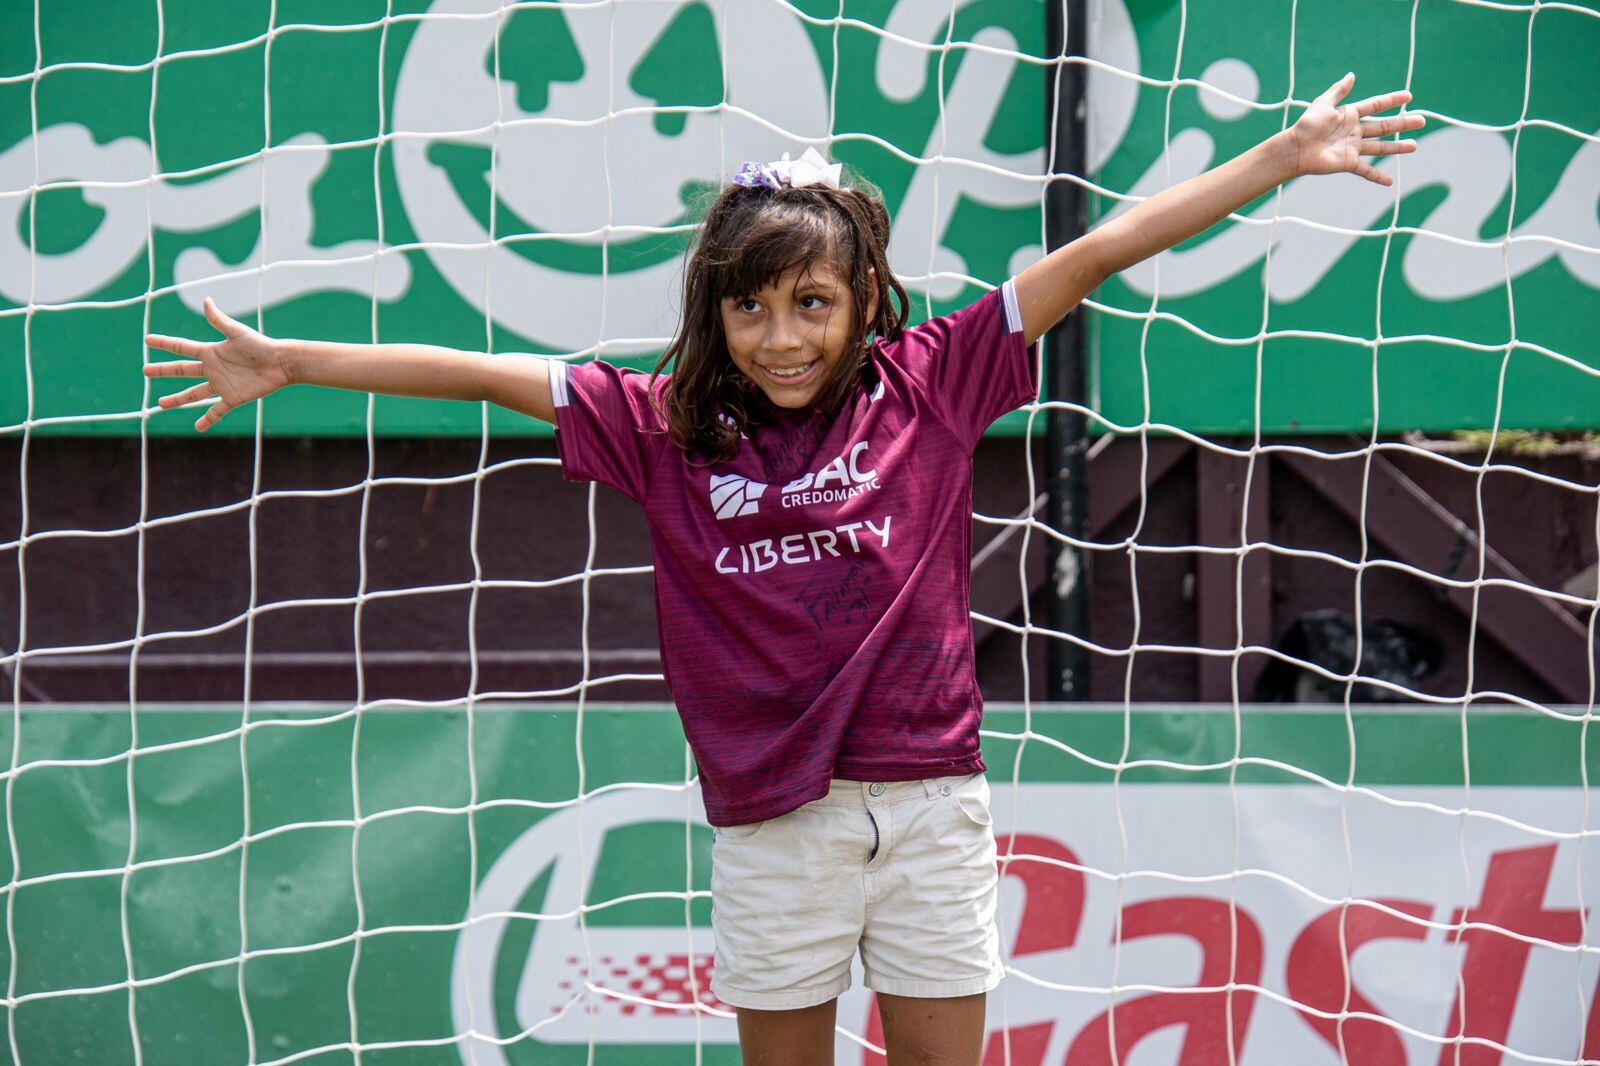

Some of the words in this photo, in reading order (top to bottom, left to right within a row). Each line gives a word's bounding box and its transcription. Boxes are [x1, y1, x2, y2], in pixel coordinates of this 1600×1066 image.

[875, 0, 1600, 302] Pin
[714, 516, 892, 574] LIBERTY
[782, 478, 881, 508] CREDOMATIC
[862, 832, 1600, 1066] ast
